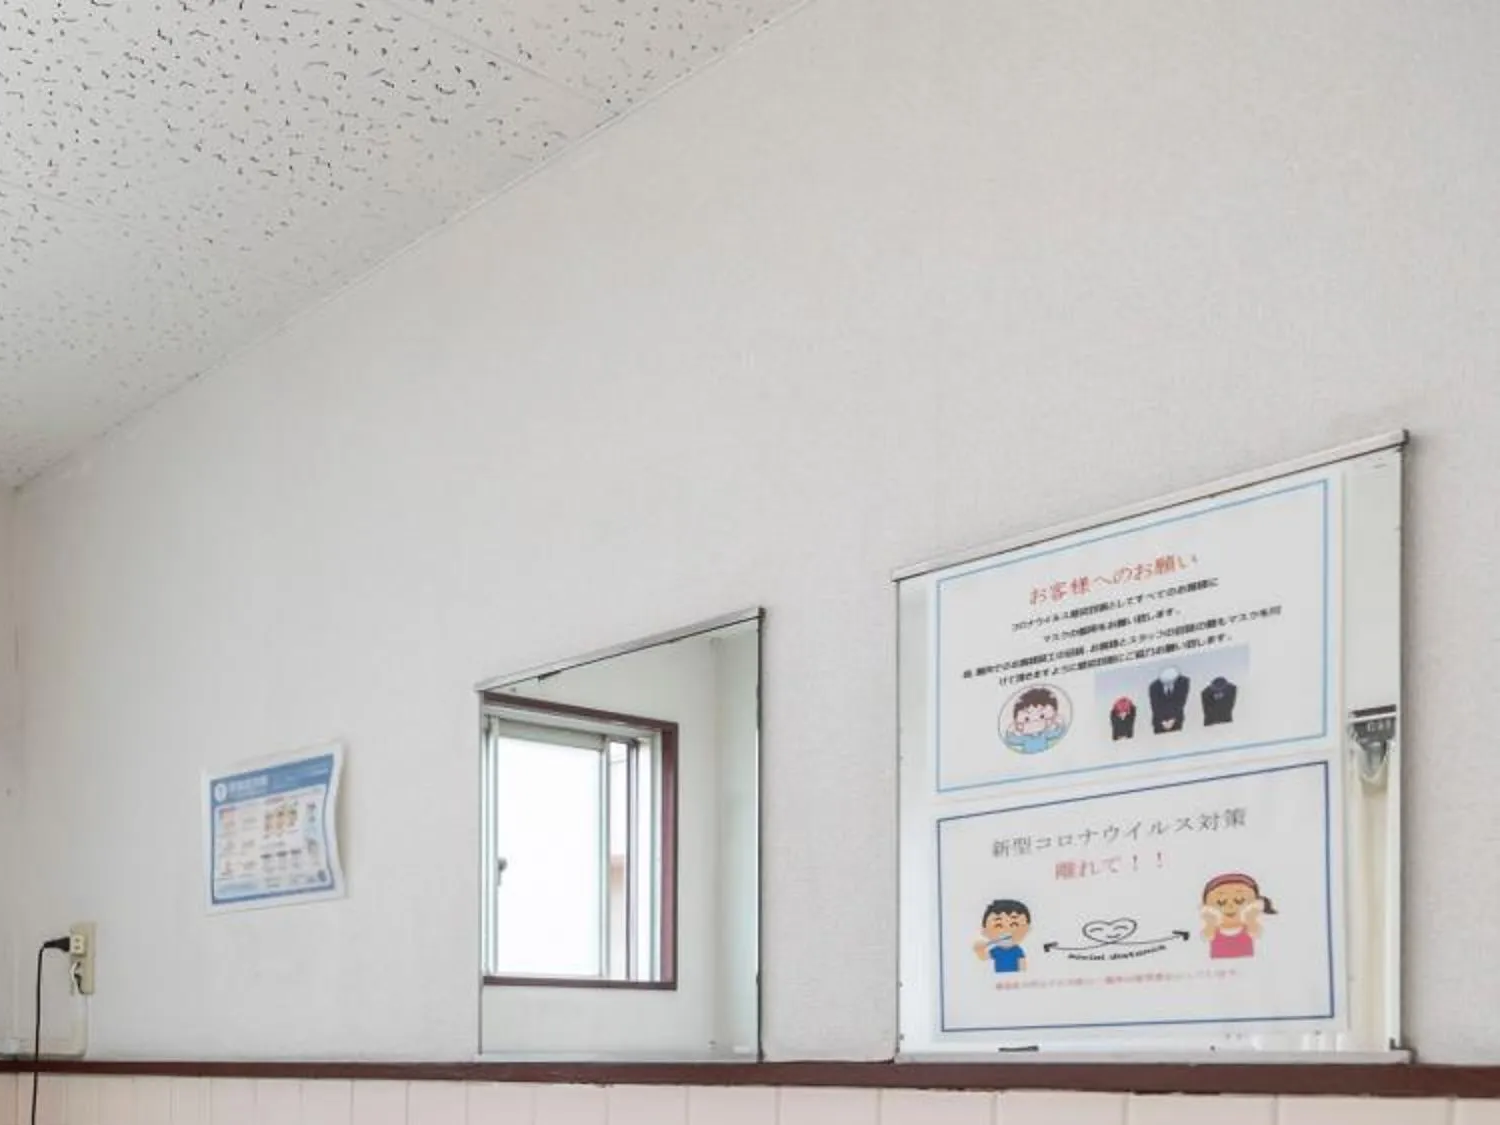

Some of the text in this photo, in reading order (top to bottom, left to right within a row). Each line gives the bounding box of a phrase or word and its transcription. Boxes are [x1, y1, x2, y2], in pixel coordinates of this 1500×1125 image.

[1029, 553, 1201, 606] お客様へのお願い
[991, 807, 1248, 858] 新型コロナウイルス対策
